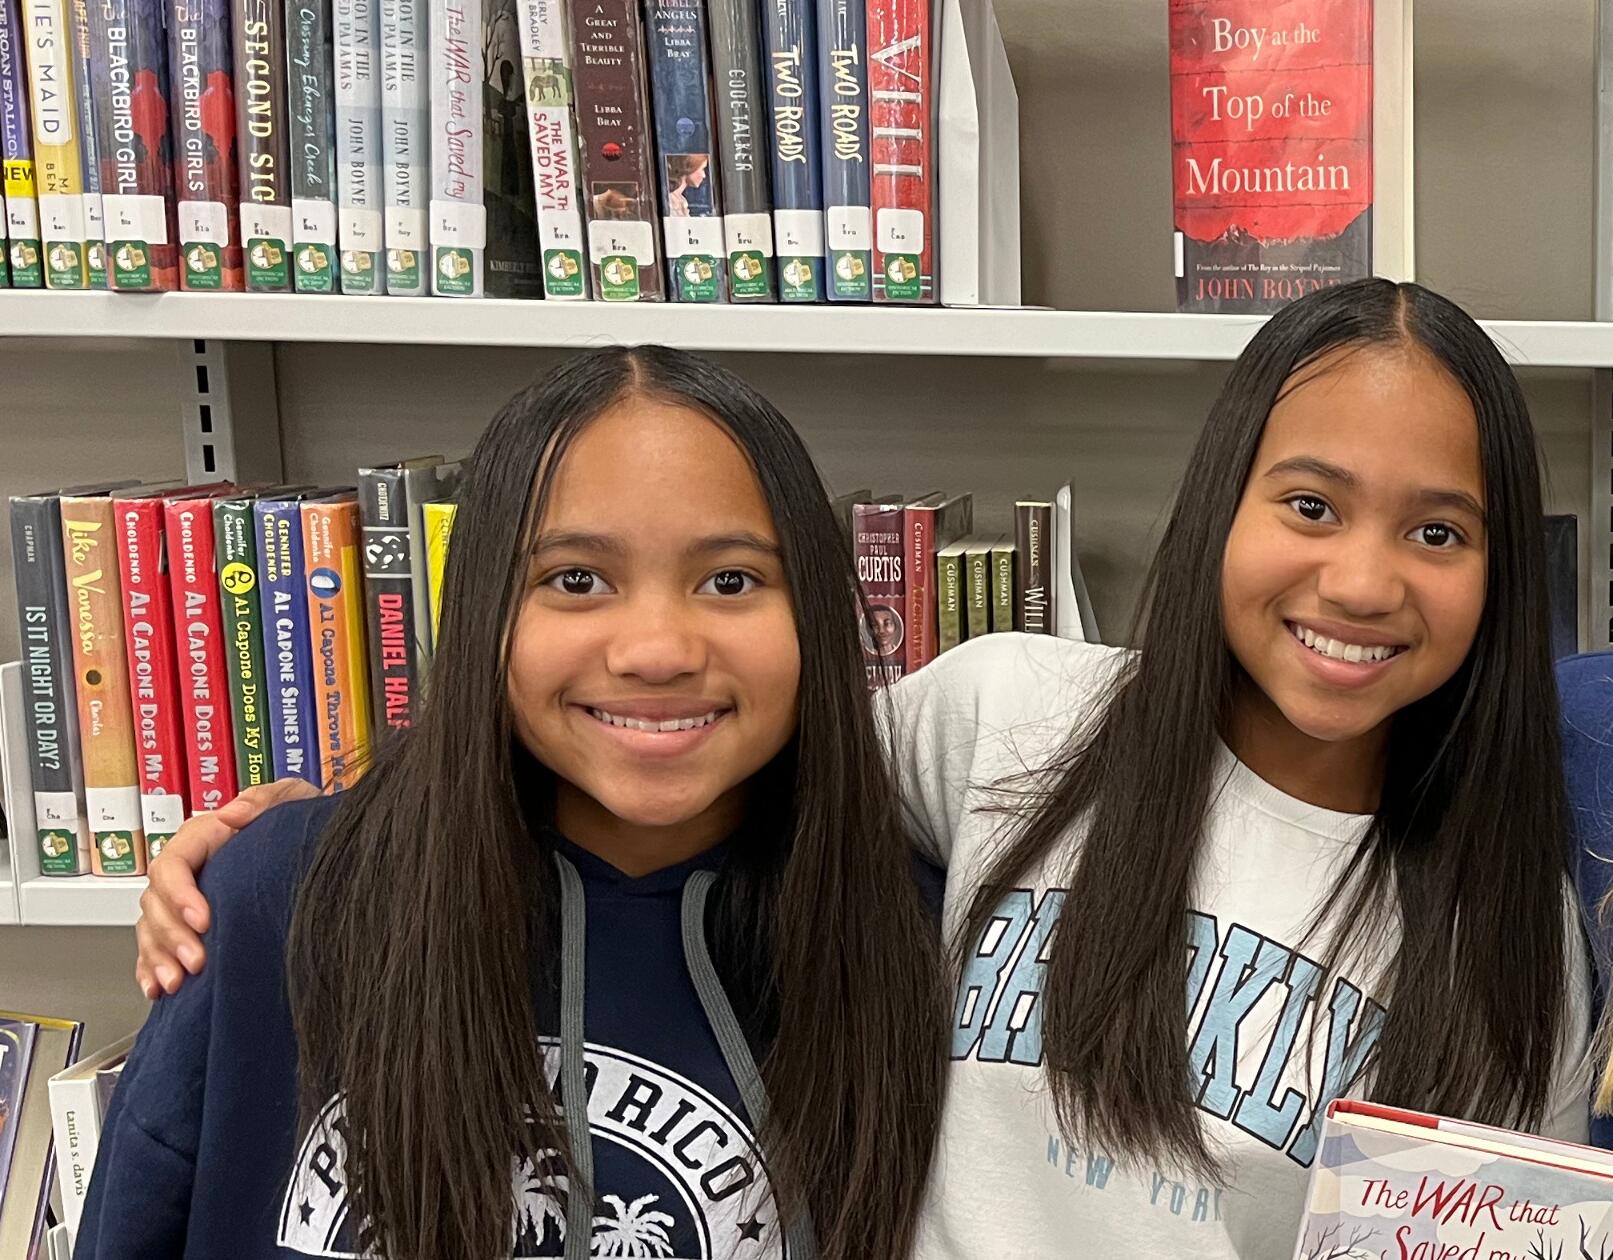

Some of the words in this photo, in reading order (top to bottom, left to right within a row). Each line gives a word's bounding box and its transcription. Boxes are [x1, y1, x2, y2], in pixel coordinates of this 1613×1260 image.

[355, 27, 368, 47] IN
[447, 7, 465, 35] The
[528, 4, 541, 52] BRADLEY
[585, 17, 617, 28] GREAT
[591, 32, 612, 40] AND
[655, 10, 698, 20] ANGELS
[0, 28, 11, 77] ROAN
[294, 8, 315, 68] Crossing
[339, 24, 352, 90] PAJAMAS
[384, 24, 398, 91] PAJAMAS
[400, 30, 413, 46] IN
[580, 42, 624, 53] TERRIBLE
[664, 37, 692, 47] LIBBA
[667, 48, 692, 58] BRAY
[1211, 18, 1267, 61] Boy
[1271, 31, 1290, 46] at
[1294, 23, 1321, 44] the
[181, 29, 201, 131] BLACKBIRD
[244, 20, 273, 138] SECOND
[356, 51, 369, 80] THE
[401, 53, 414, 82] THE
[443, 38, 472, 85] WAR
[585, 56, 622, 66] BEAUTY
[771, 44, 802, 97] TWO
[830, 43, 860, 96] TWO
[39, 64, 60, 133] MAID
[108, 28, 135, 143] BLACKBIRD
[297, 74, 320, 137] Ebenezer
[450, 90, 466, 118] that
[729, 69, 747, 109] CODE
[594, 104, 623, 114] LIBBA
[596, 117, 623, 127] BRAY
[871, 34, 922, 182] VIII
[1202, 86, 1264, 131] Top
[1271, 95, 1293, 118] of
[1299, 93, 1332, 117] the
[349, 120, 363, 154] JOHN
[394, 120, 409, 156] JOHN
[444, 120, 474, 179] Saved
[533, 112, 551, 168] SAVED
[550, 120, 563, 145] THE
[731, 114, 753, 172] TALKER
[774, 106, 806, 163] ROADS
[831, 104, 863, 163] ROADS
[46, 163, 56, 191] BEN
[186, 138, 204, 191] GIRLS
[305, 143, 323, 187] Creek
[351, 161, 365, 205] BOYNE
[396, 161, 411, 206] BOYNE
[553, 150, 570, 190] WAR
[1185, 154, 1351, 195] Mountain
[539, 173, 555, 201] MY
[1196, 278, 1254, 300] JOHN
[25, 524, 36, 563] CHAPMAN
[64, 519, 103, 566] Like
[125, 511, 142, 584] CHOLDENKO
[179, 511, 197, 584] CHOLDENKO
[223, 513, 236, 561] Choldenko
[235, 517, 248, 557] Gennifer
[263, 513, 278, 583] CHOLDENKO
[278, 519, 292, 577] GENNIFER
[309, 512, 321, 563] Choldenko
[321, 516, 334, 560] Gennifer
[858, 532, 901, 545] CHRISTOPHER
[869, 544, 888, 556] PAUL
[913, 522, 924, 573] CUSHMAN
[1030, 519, 1040, 568] CUSHMAN
[858, 556, 902, 583] CURTIS
[947, 562, 957, 612] CUSHMAN
[974, 560, 984, 609] CUSHMAN
[1000, 558, 1009, 607] CUSHMAN
[25, 606, 47, 623] IS
[72, 569, 107, 656] Vanessa
[129, 590, 151, 619] AL
[184, 590, 207, 619] AL
[235, 596, 250, 618] Al
[273, 590, 292, 614] AL
[319, 603, 335, 624] Al
[1023, 586, 1048, 632] WILL
[27, 626, 48, 642] IT
[235, 621, 252, 679] Capone
[275, 617, 295, 683] CAPONE
[378, 593, 407, 670] DANIEL
[29, 646, 54, 696] NIGHT
[132, 621, 155, 699] CAPONE
[187, 621, 211, 700] CAPONE
[320, 628, 337, 686] Capone
[34, 701, 56, 725] OR
[242, 683, 257, 723] Does
[281, 686, 299, 744] SHINES
[139, 703, 159, 750] DOES
[194, 705, 214, 751] DOES
[244, 726, 261, 749] My
[36, 729, 61, 771] DAY?
[144, 754, 164, 783] MY
[199, 755, 220, 784] MY
[285, 748, 304, 773] MY
[66, 1110, 80, 1149] tanita
[604, 1072, 755, 1202] RICO
[72, 1163, 85, 1197] davis
[1047, 1134, 1116, 1190] NEW
[1150, 1171, 1224, 1222] YORK
[1361, 1180, 1410, 1210] The
[1410, 1176, 1507, 1232] WAR
[1509, 1200, 1562, 1226] that
[1395, 1226, 1486, 1260] Saved
